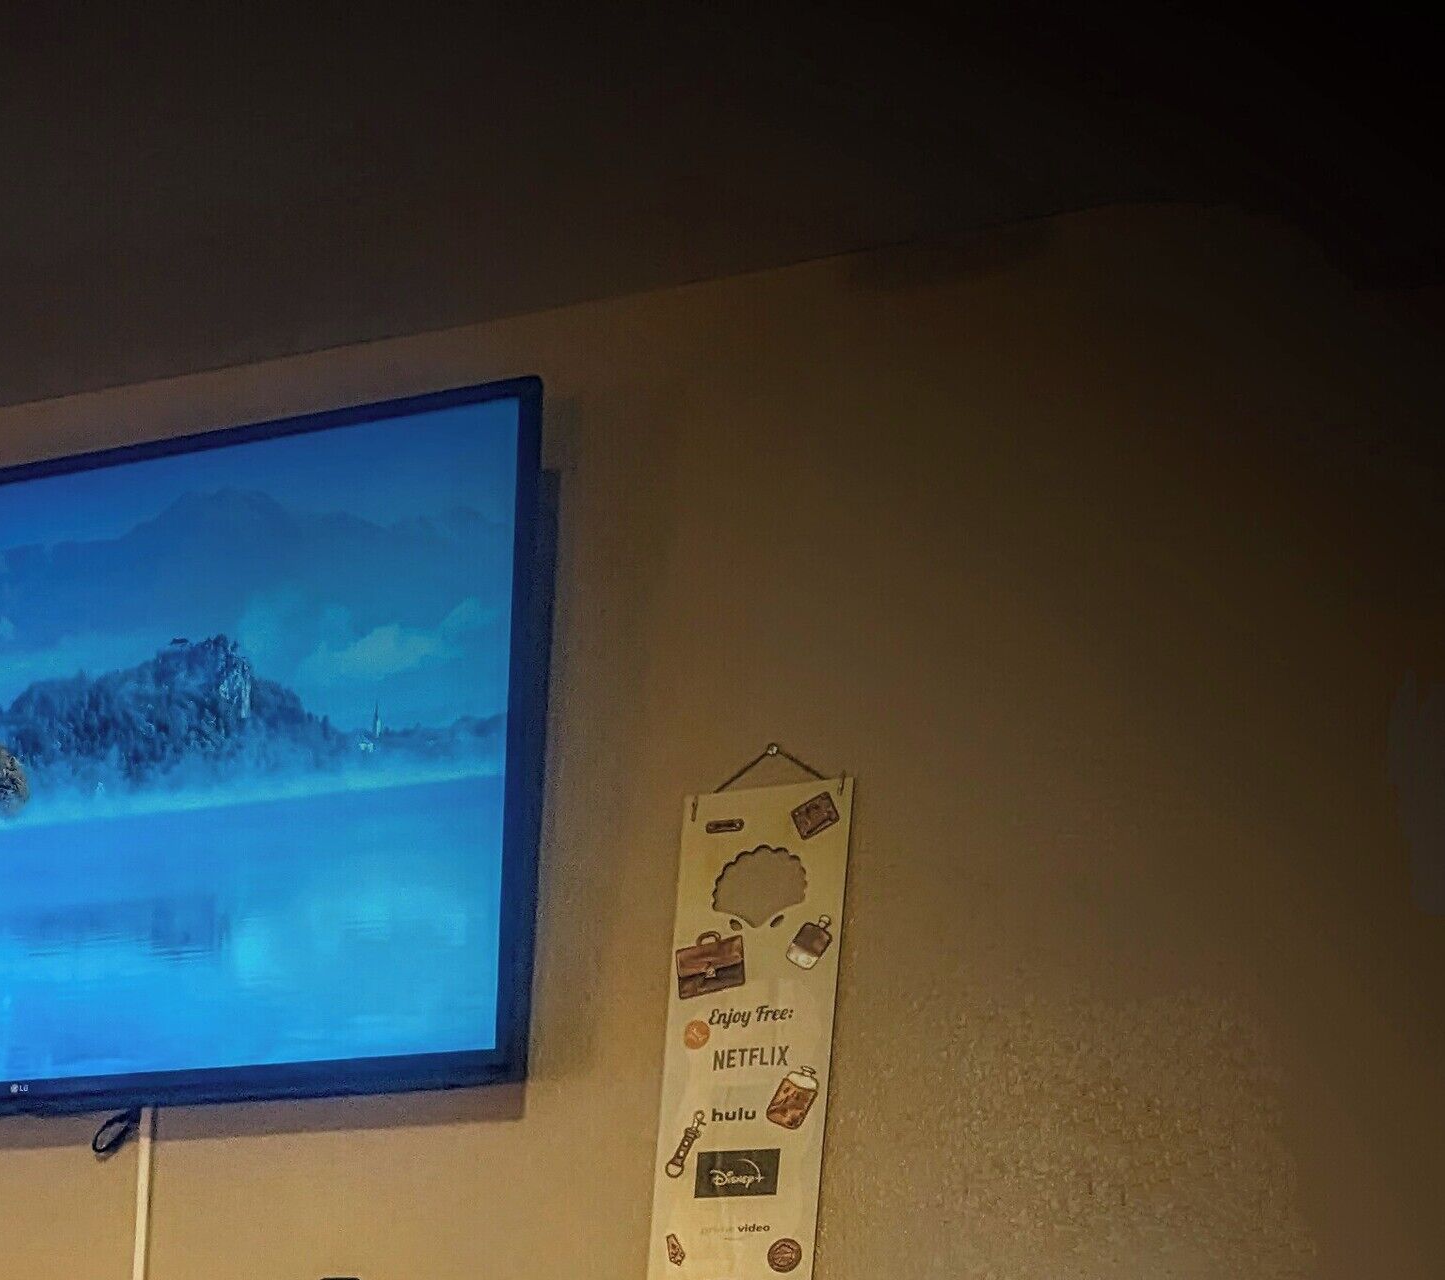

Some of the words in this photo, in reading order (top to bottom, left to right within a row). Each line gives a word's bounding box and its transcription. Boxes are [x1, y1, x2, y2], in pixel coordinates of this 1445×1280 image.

[708, 1008, 752, 1030] Enjoy
[756, 1005, 794, 1022] Free:
[713, 1045, 790, 1071] NETFLIX
[18, 1084, 29, 1092] LG
[711, 1107, 757, 1122] hulu
[710, 1161, 764, 1189] Disney+
[737, 1223, 771, 1233] video
